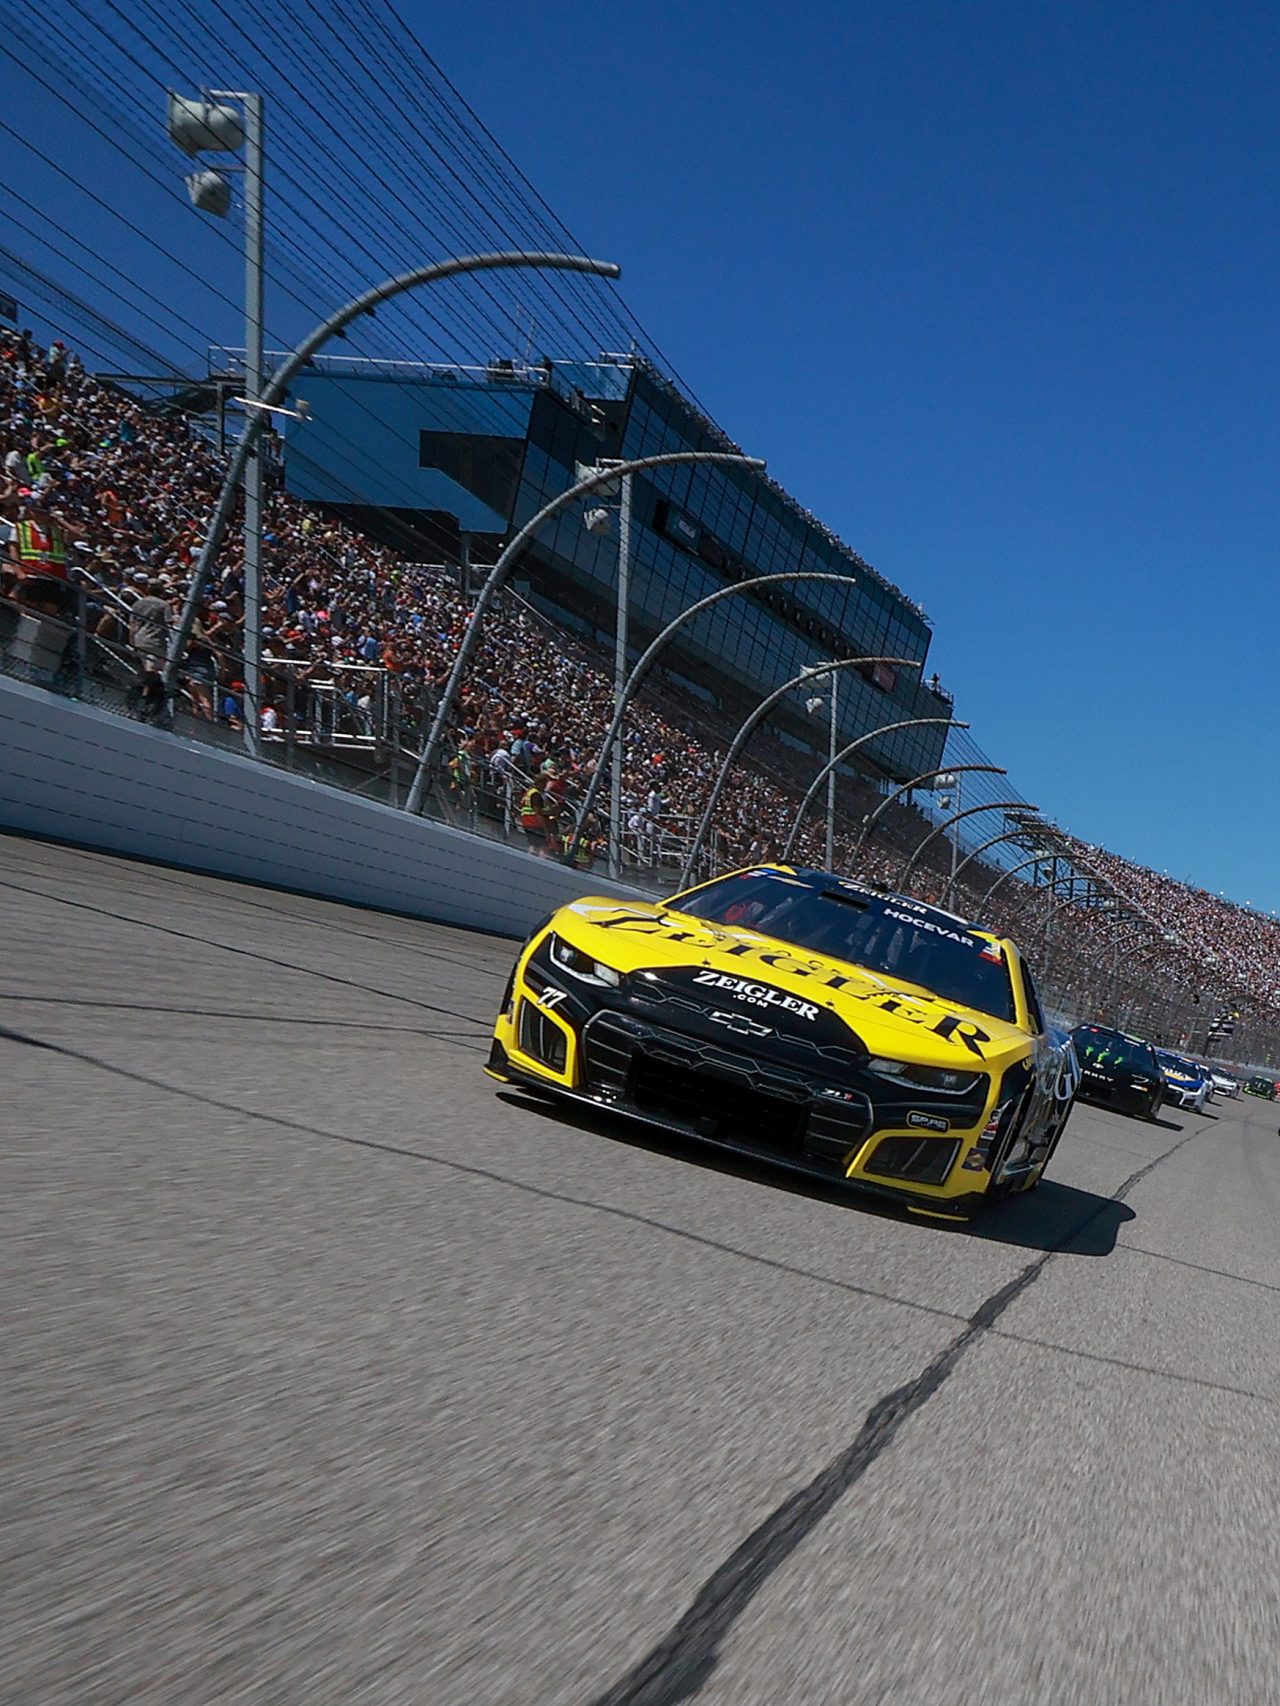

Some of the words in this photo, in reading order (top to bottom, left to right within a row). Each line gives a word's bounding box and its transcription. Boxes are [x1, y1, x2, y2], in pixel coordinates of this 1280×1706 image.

[884, 908, 974, 948] HOCEVAR
[537, 986, 568, 1009] 77
[585, 908, 991, 1062] ZEIGLER
[692, 970, 819, 1021] ZEIGLER
[733, 993, 768, 1008] .COM
